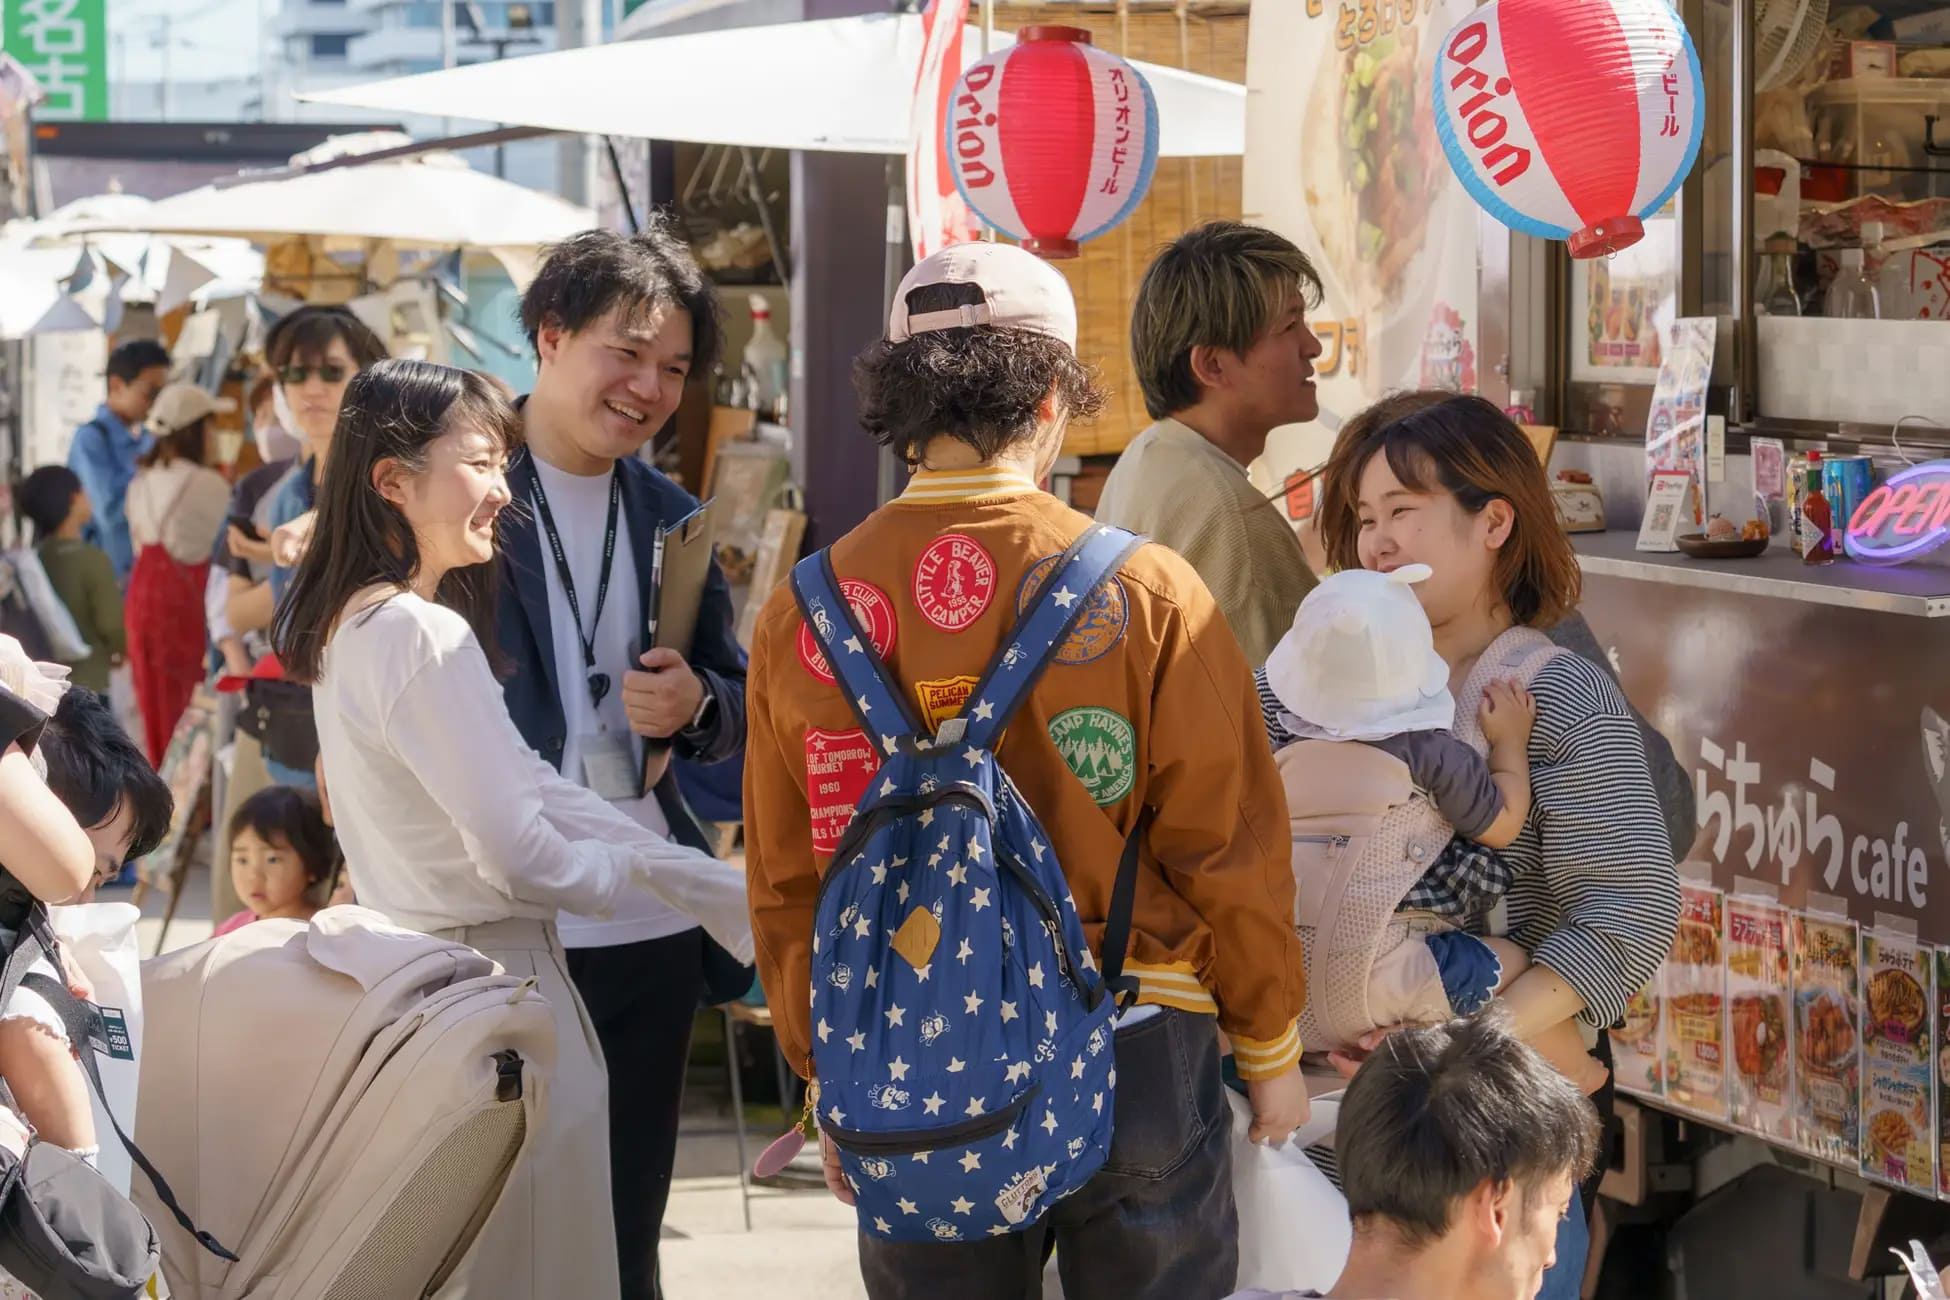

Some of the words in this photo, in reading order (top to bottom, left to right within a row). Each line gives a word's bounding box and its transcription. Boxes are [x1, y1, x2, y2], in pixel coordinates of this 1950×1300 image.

[1447, 21, 1531, 187] Orion
[957, 65, 997, 189] Orion
[1100, 68, 1131, 194] オリオンビール
[919, 550, 945, 608] LITTLE
[951, 541, 990, 587] BEAVER
[852, 586, 878, 607] CLUB
[930, 595, 984, 625] CAMPER
[929, 686, 969, 700] PELICAN
[1089, 714, 1131, 755] HAYNES
[823, 748, 872, 763] TOMORROW
[819, 781, 841, 794] 1960
[1101, 764, 1132, 798] AMERICA
[1851, 821, 1929, 909] cafe
